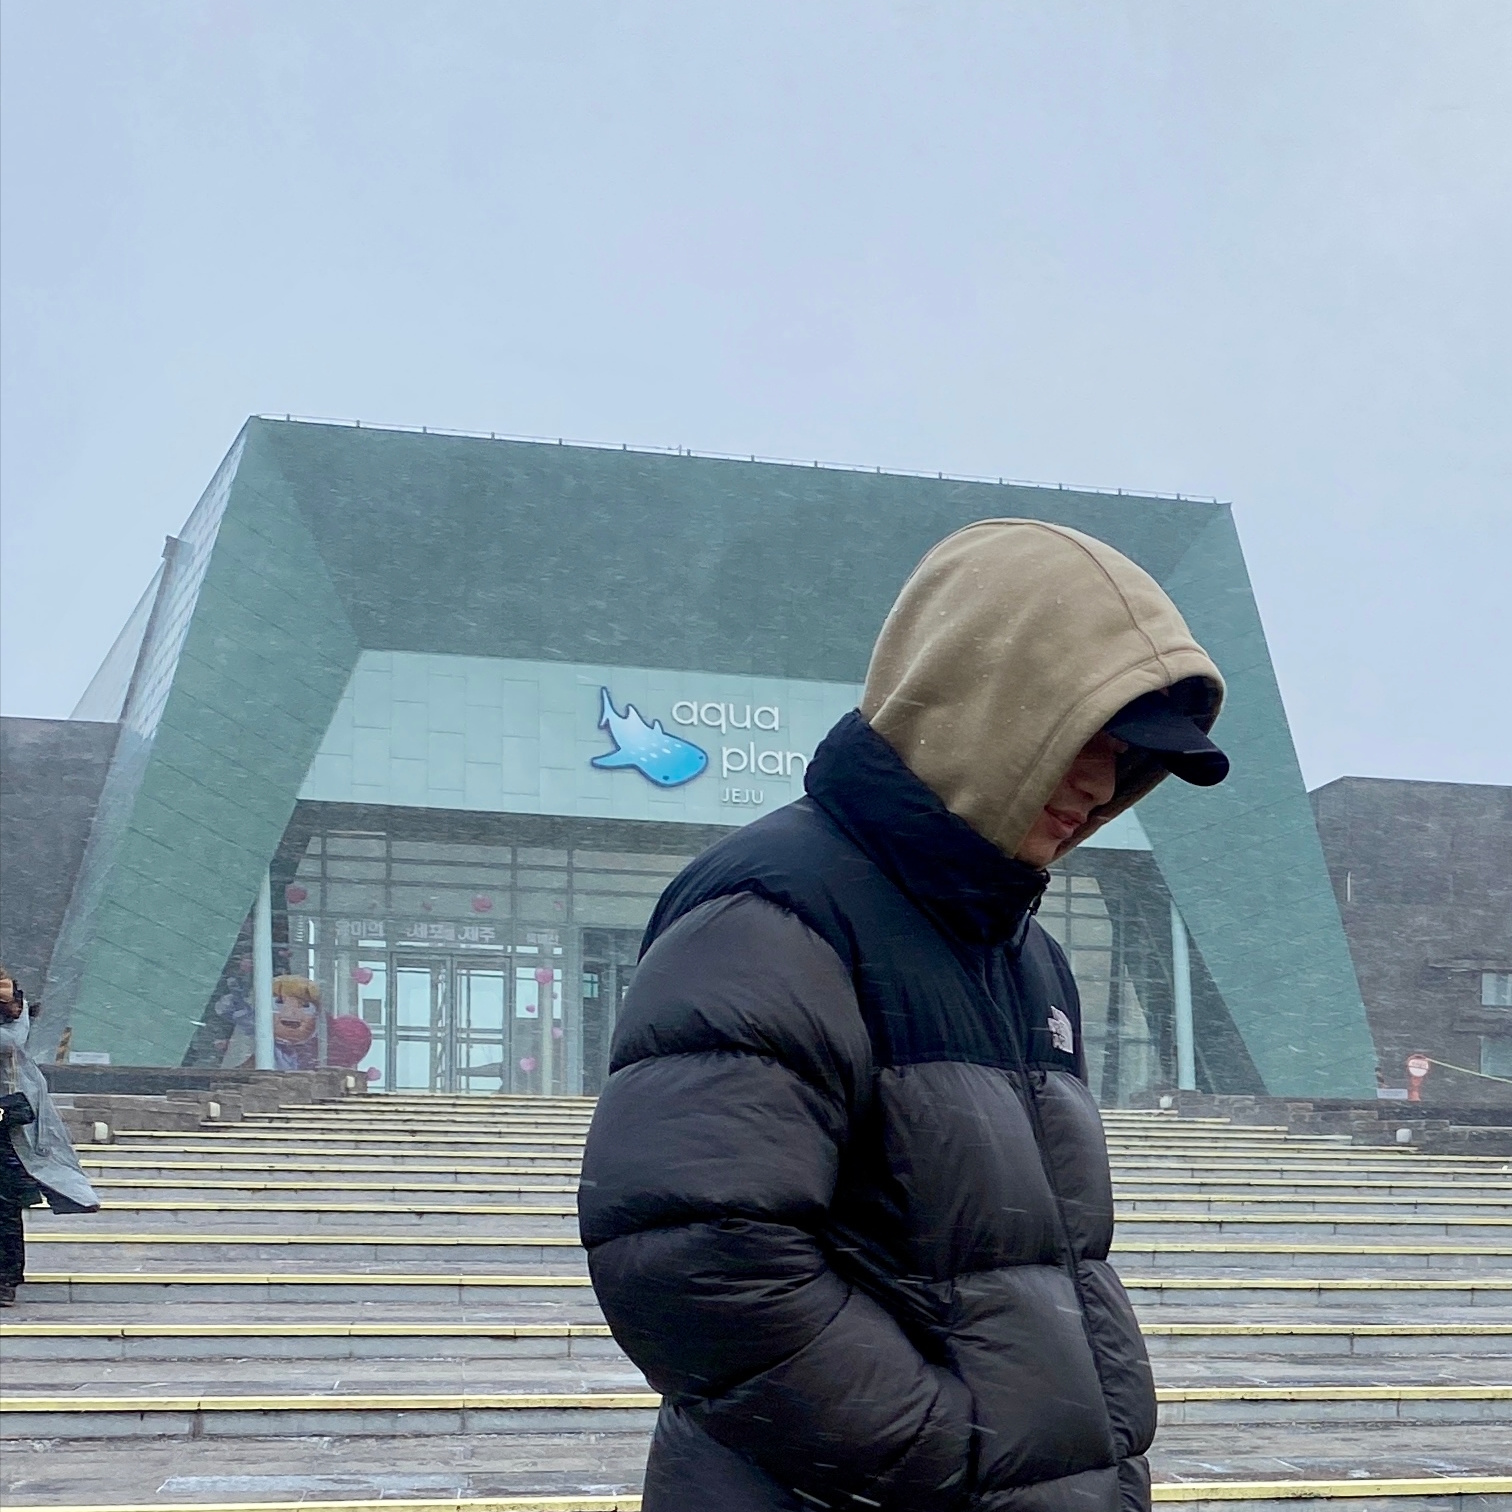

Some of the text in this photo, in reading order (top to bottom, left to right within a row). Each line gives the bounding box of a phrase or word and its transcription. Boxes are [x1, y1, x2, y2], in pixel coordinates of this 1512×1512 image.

[671, 700, 780, 735] aqua
[722, 741, 809, 778] plan
[722, 787, 765, 805] JEJU
